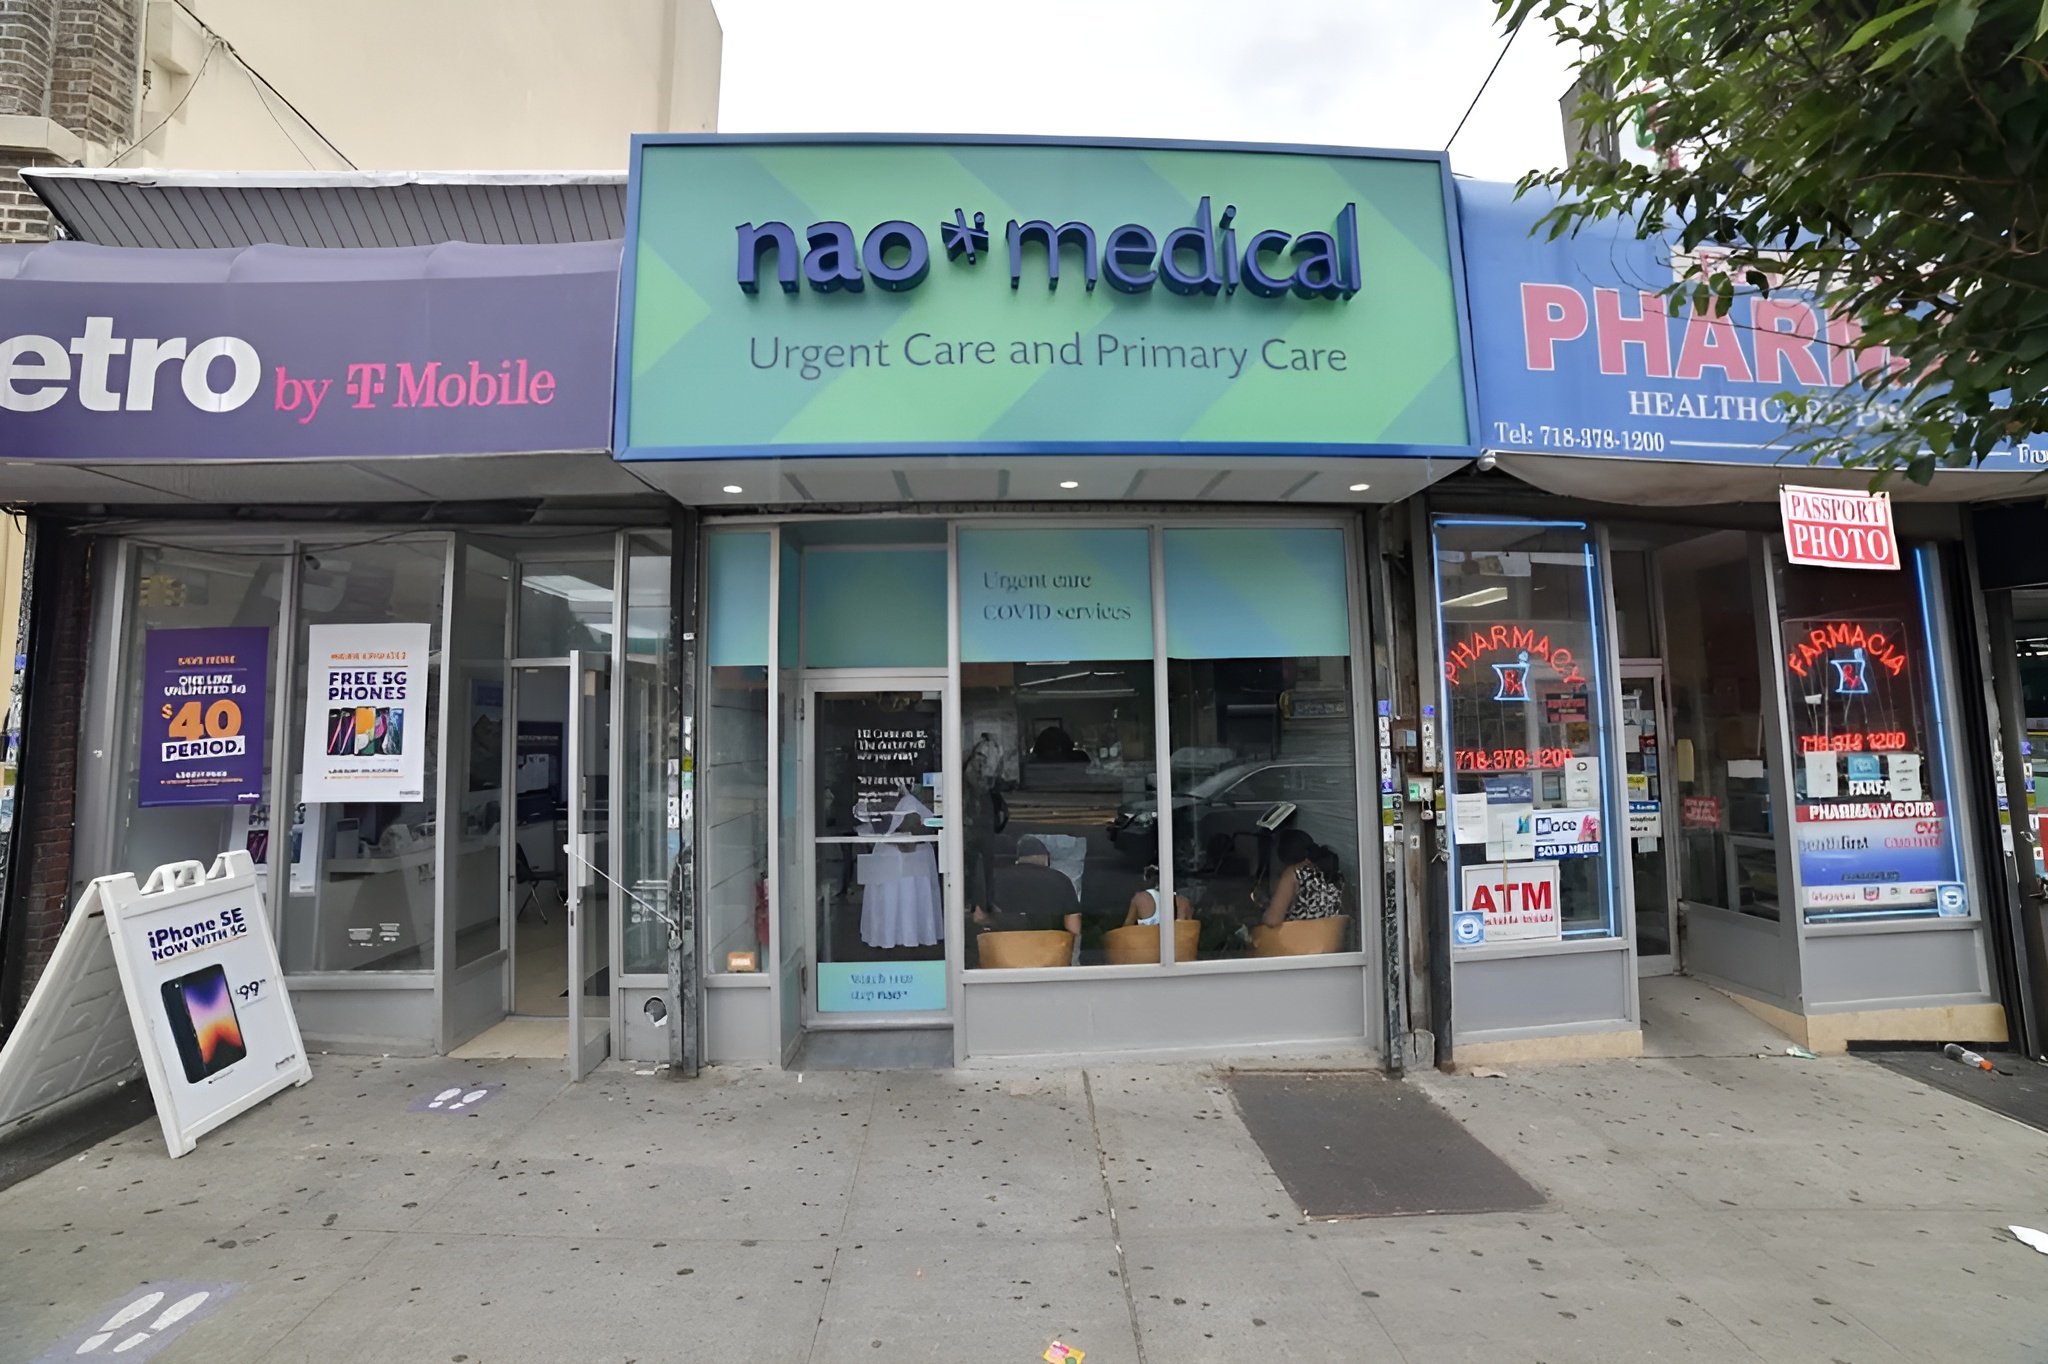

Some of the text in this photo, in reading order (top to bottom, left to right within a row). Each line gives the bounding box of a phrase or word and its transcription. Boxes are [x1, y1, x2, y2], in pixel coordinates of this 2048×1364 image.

[735, 195, 1362, 301] nao medical
[750, 331, 1348, 380] Urgent Care and Primary Care
[274, 366, 333, 424] by
[392, 359, 556, 408] Mobile
[1790, 494, 1888, 523] PASSPORT
[1793, 523, 1889, 561] PHOTO
[983, 572, 1047, 593] Urgent
[983, 602, 1131, 620] COVID services
[1446, 625, 1587, 690] PHARMACY
[1788, 622, 1907, 678] FARMACIA
[328, 687, 406, 701] PHONES
[329, 671, 407, 685] FREE 5G
[165, 741, 243, 760] PERIOD.
[1472, 881, 1552, 913] ATM
[148, 908, 244, 948] iPhone SE
[152, 941, 188, 961] NOW
[191, 929, 228, 948] WITH
